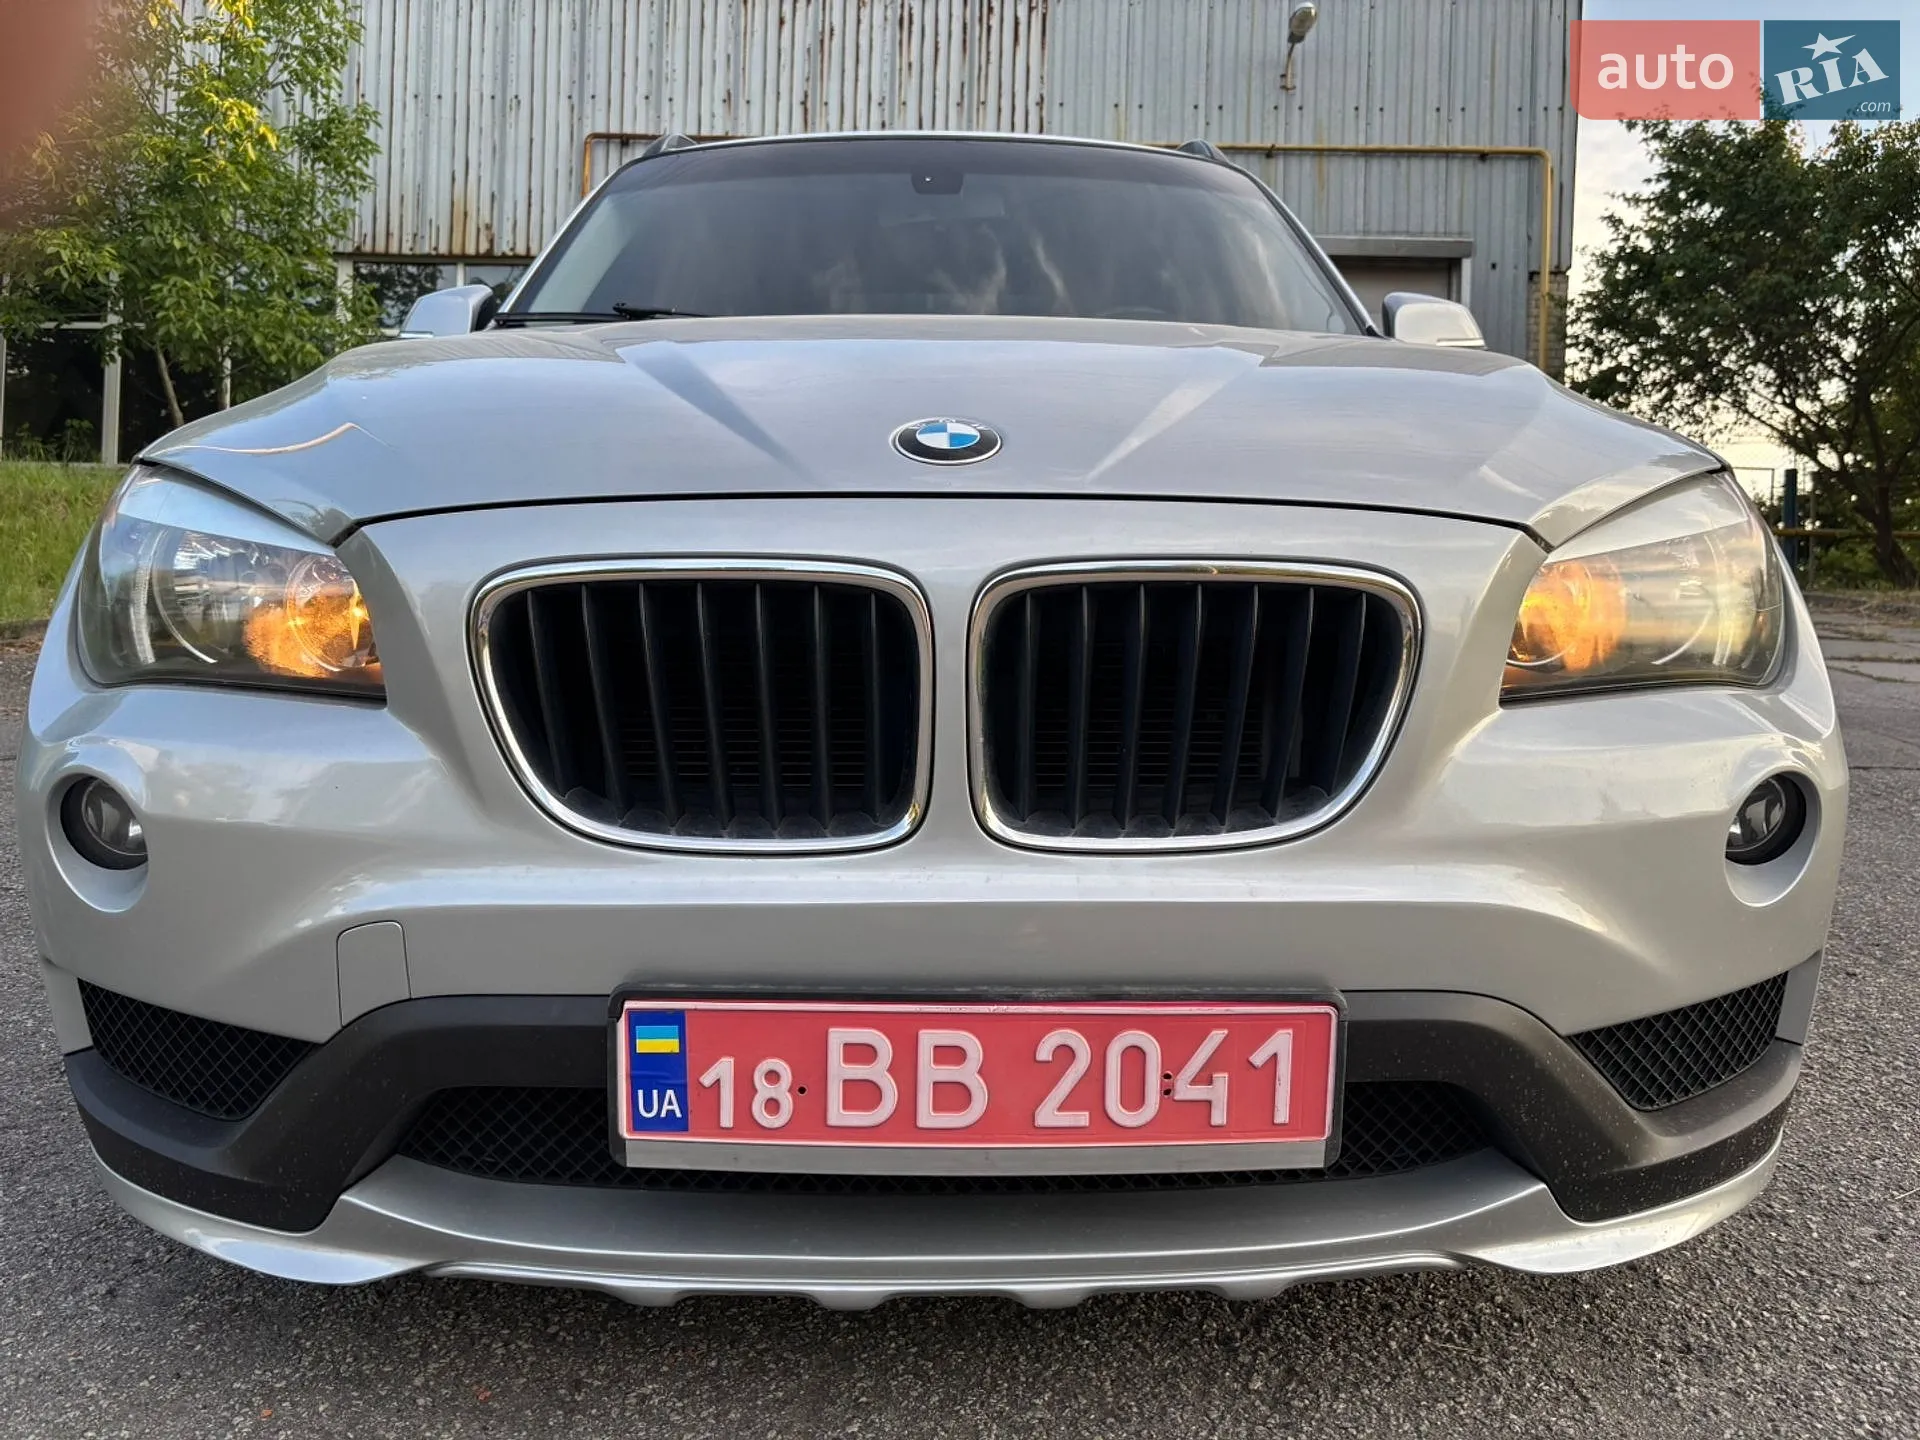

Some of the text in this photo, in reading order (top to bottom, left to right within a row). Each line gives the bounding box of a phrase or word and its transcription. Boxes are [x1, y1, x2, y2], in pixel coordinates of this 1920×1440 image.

[637, 1089, 682, 1119] UA
[699, 1027, 1294, 1129] 18 BB 2041
